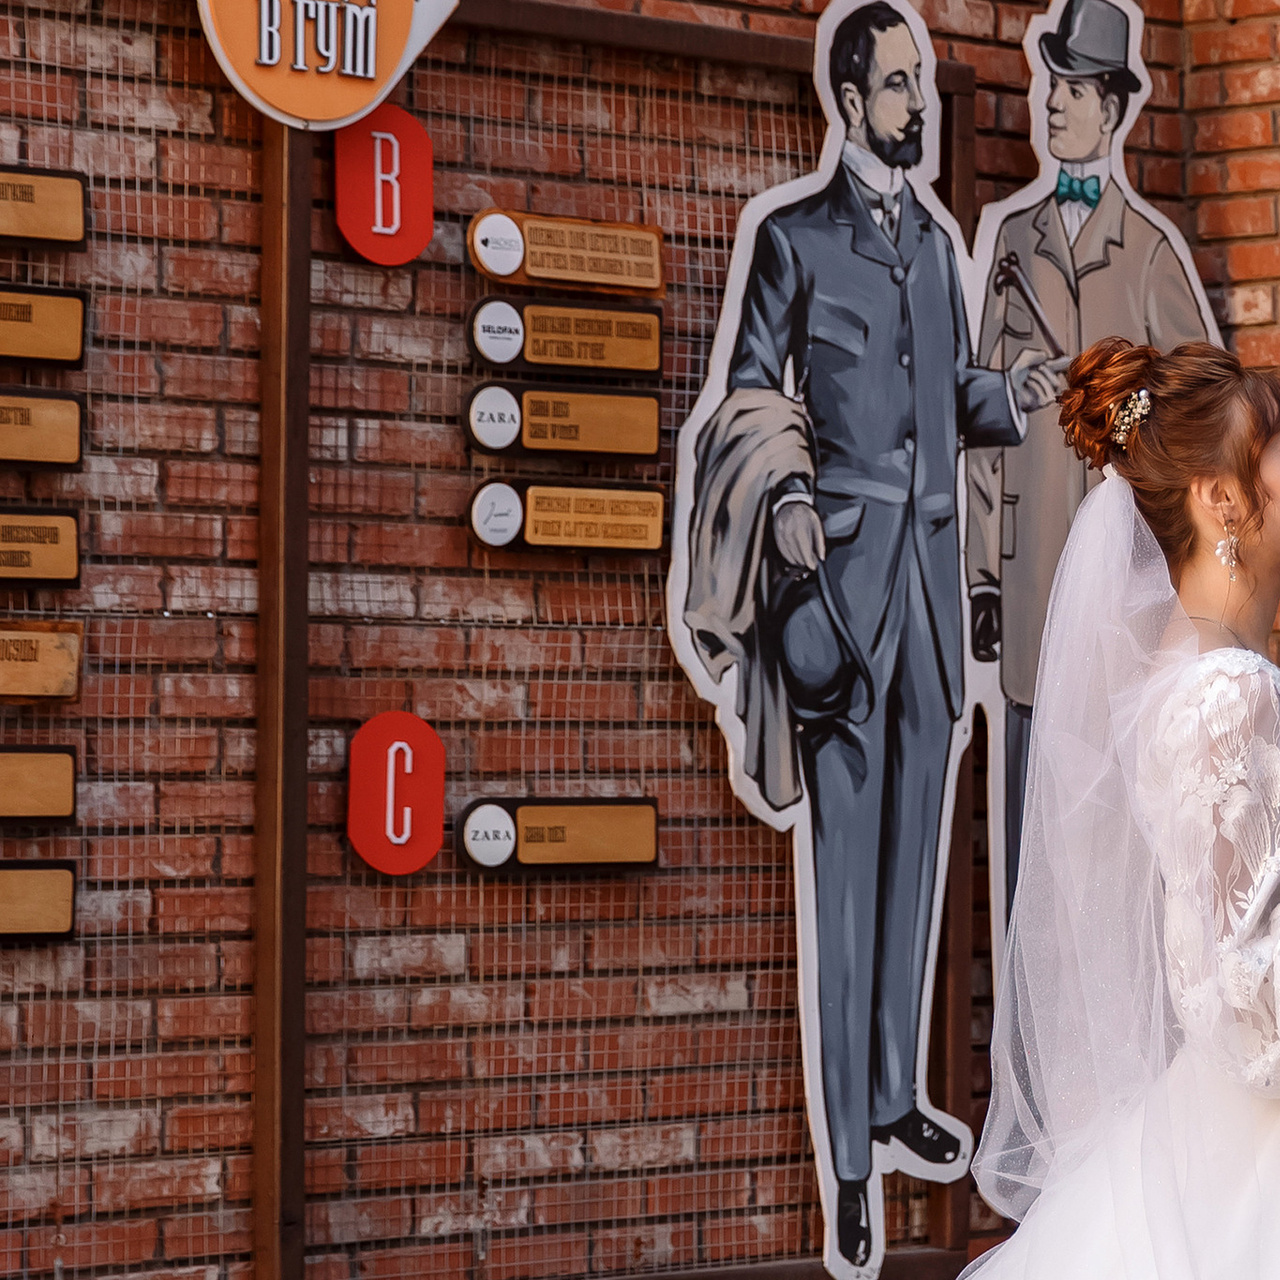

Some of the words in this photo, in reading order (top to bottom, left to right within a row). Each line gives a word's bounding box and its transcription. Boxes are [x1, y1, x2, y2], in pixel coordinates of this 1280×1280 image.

[477, 411, 517, 424] ZARA
[386, 741, 413, 845] C
[471, 830, 512, 842] ZARA
